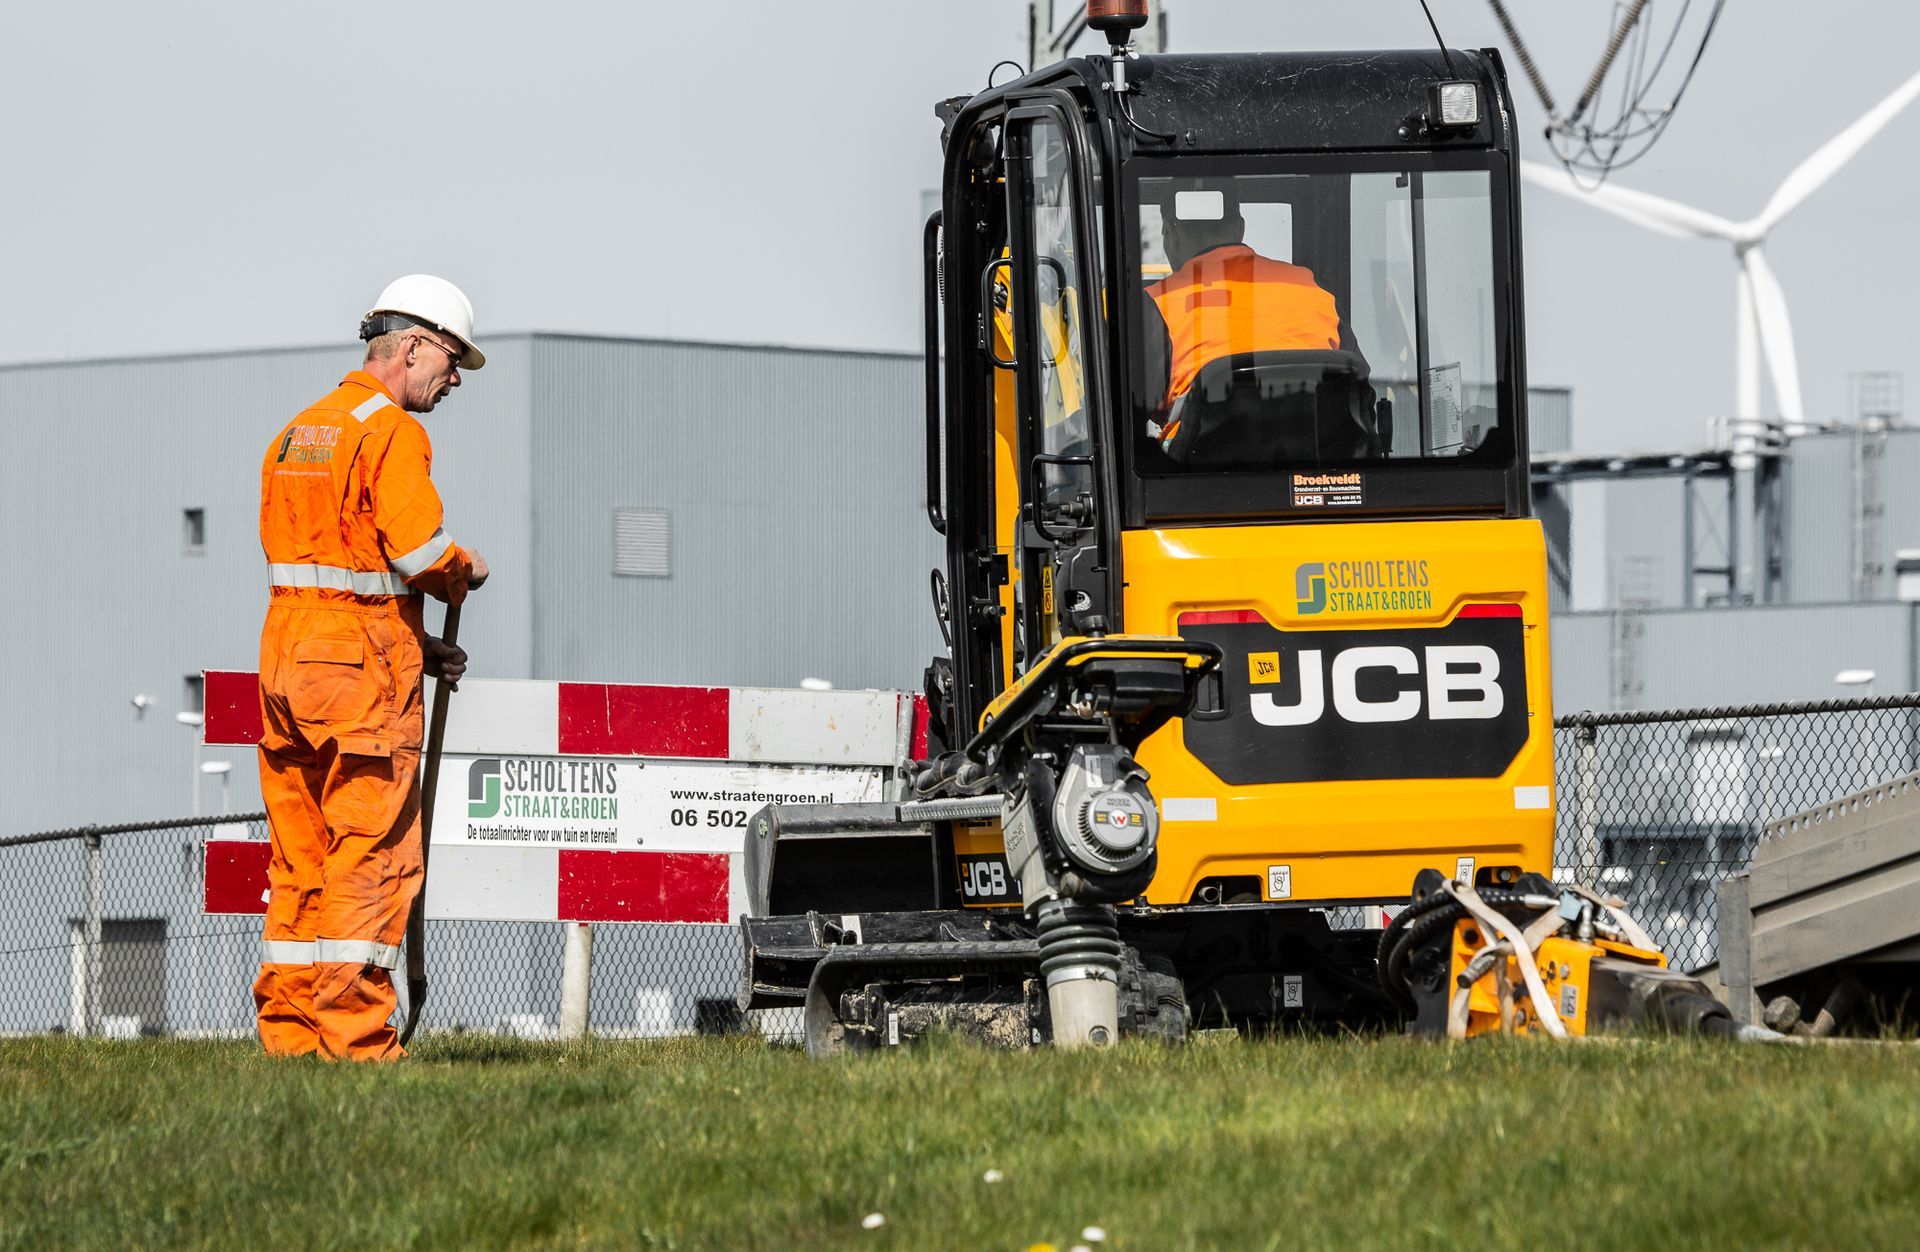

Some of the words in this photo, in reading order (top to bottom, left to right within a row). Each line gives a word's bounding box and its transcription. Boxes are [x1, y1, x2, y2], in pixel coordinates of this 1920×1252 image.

[1294, 473, 1361, 485] Broekveldt
[1295, 495, 1323, 505] JCB
[1328, 560, 1429, 589] SCHOLTENS
[1330, 590, 1431, 612] STRAAT&GROEN
[1256, 660, 1275, 675] JCB
[1250, 645, 1504, 726] JCB
[504, 760, 618, 794] SCHOLTENS
[504, 795, 618, 819] STRAAT&GROEN
[671, 790, 834, 805] www.straatengroen.nl
[671, 809, 698, 827] 06
[707, 809, 748, 828] 502
[468, 823, 477, 840] De
[479, 824, 531, 841] totaalinrichter
[533, 829, 550, 842] voor
[551, 830, 562, 842] uw
[564, 827, 578, 843] tuin
[580, 831, 589, 843] en
[591, 827, 618, 844] terrein!
[963, 862, 1007, 896] JCB
